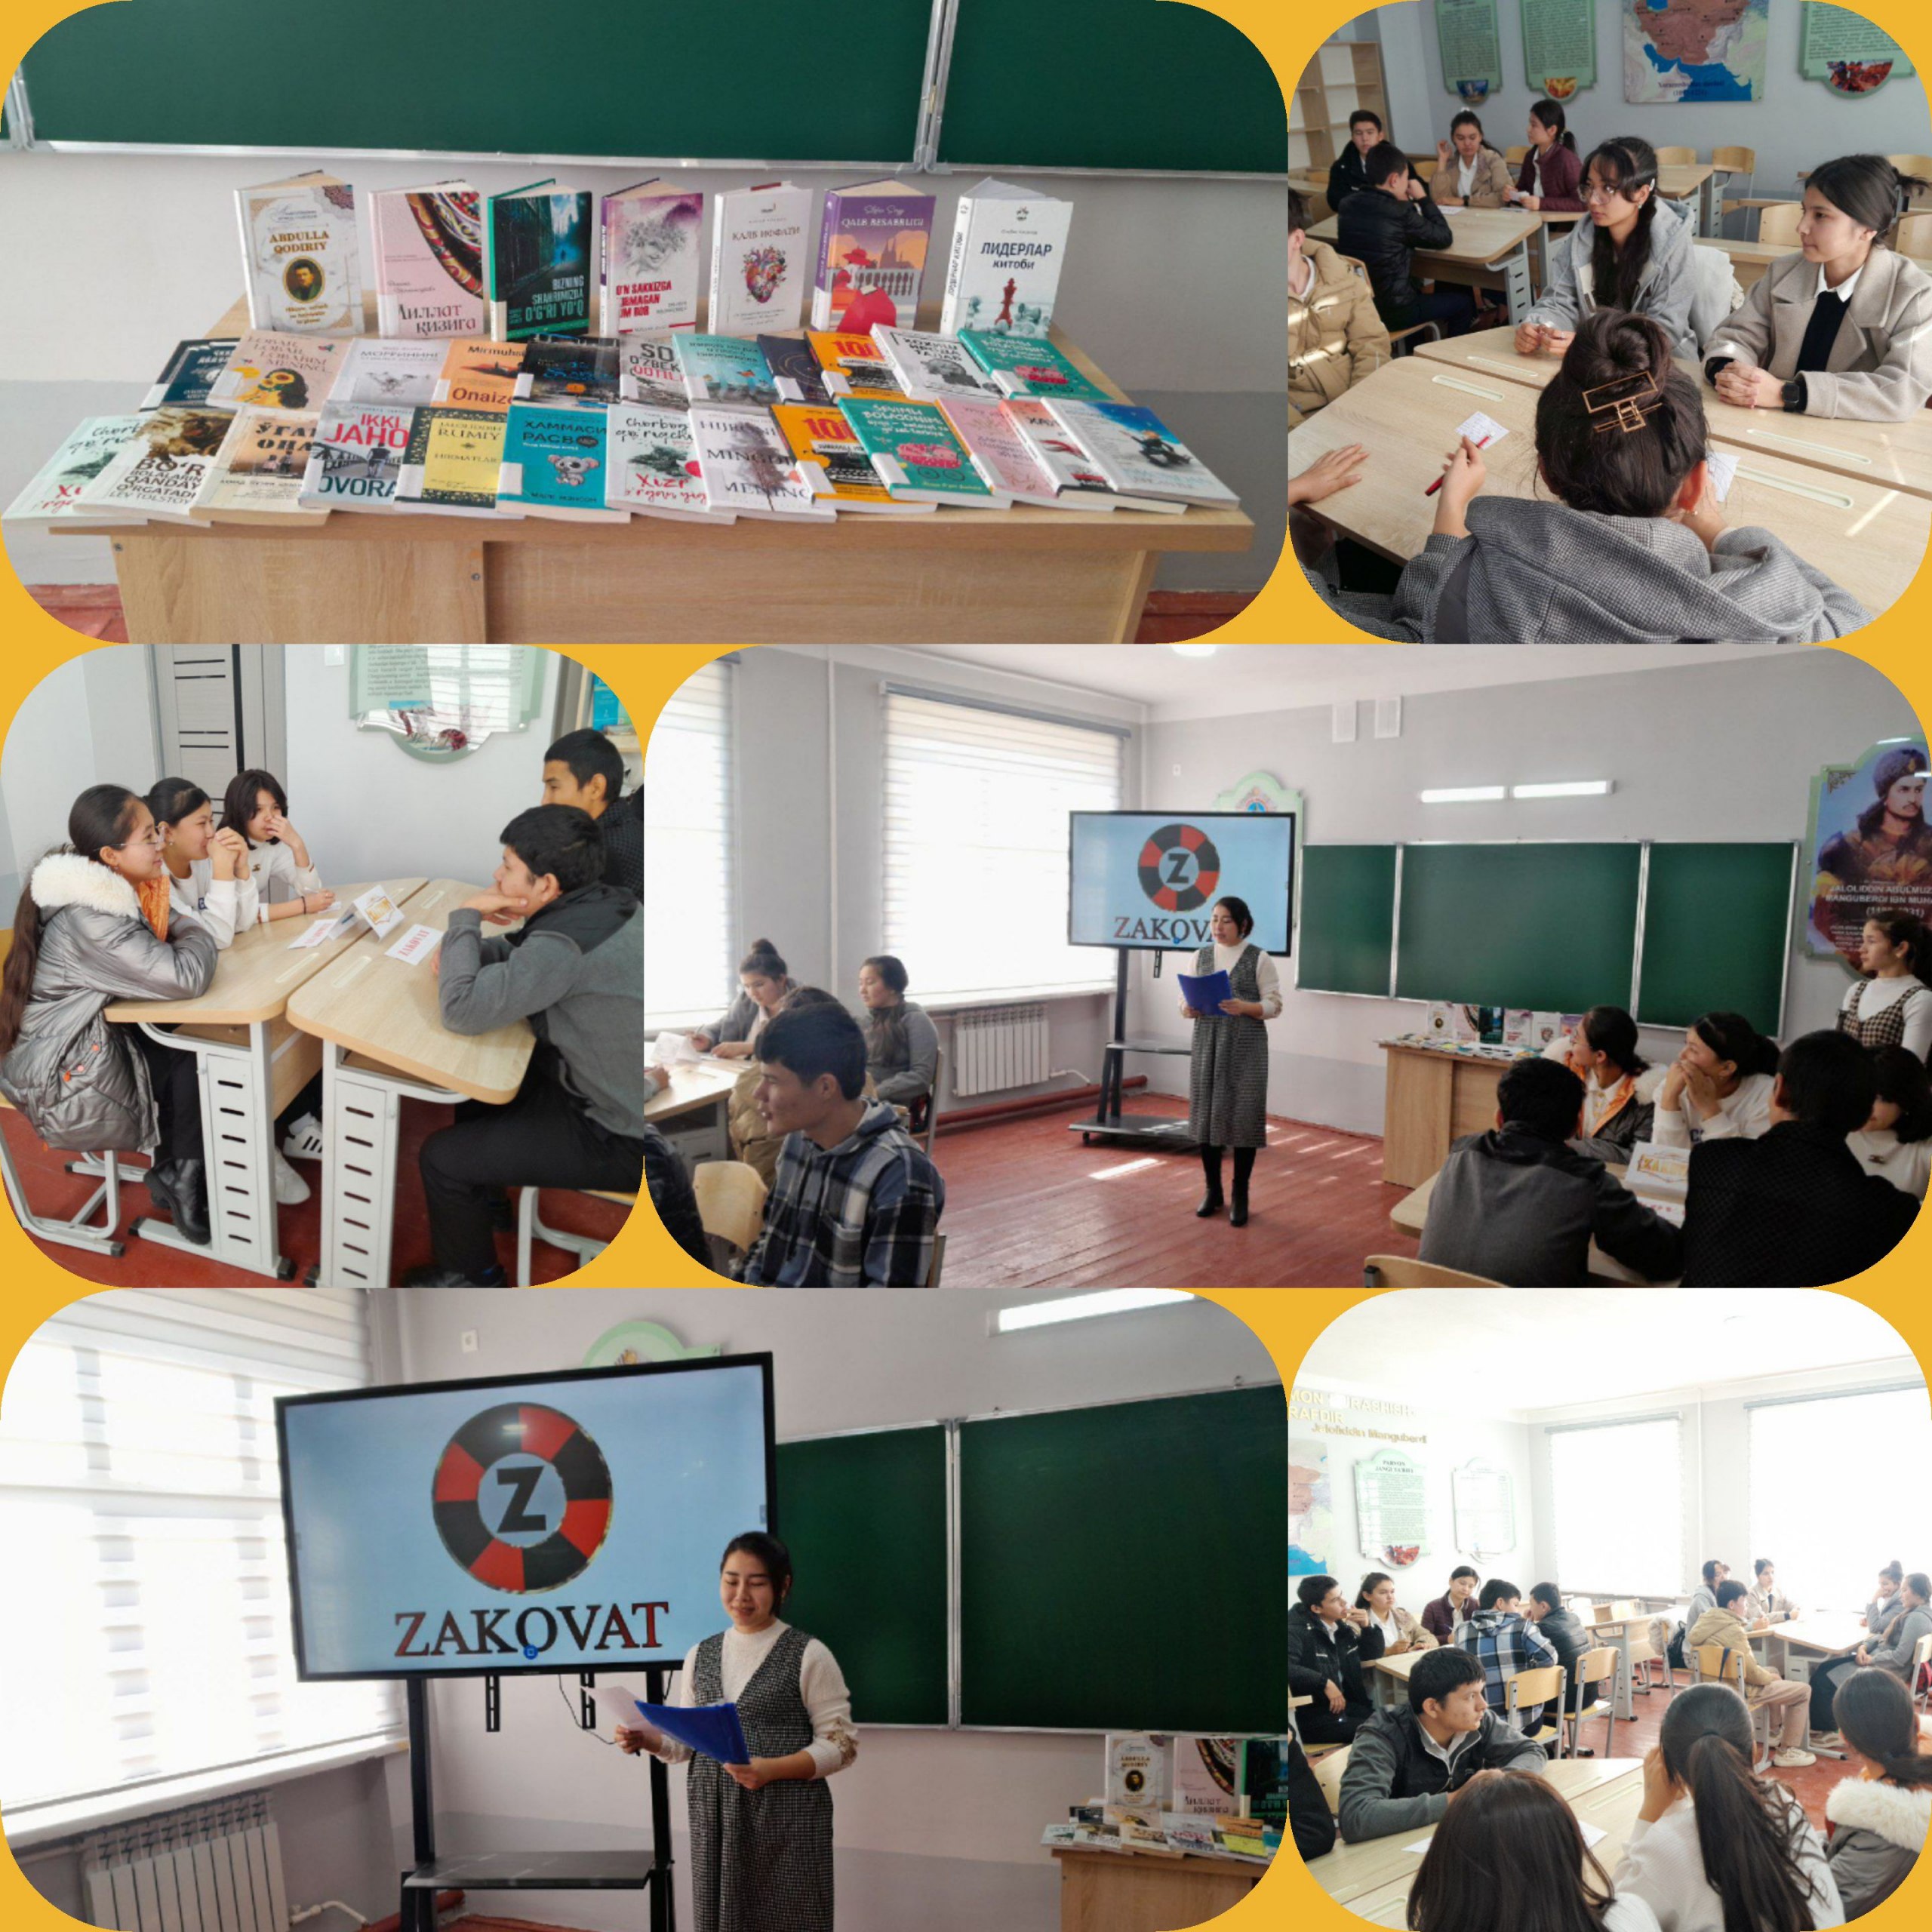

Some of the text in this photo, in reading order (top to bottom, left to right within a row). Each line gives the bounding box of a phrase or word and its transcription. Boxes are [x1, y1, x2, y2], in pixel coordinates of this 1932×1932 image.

[269, 230, 330, 243] ABDULLA
[274, 241, 327, 254] QODIRIY
[980, 242, 1053, 258] ЛИДЕРЛАР
[992, 259, 1035, 269] китоби
[361, 413, 400, 429] IKKI
[322, 423, 410, 448] JAHO
[438, 429, 500, 441] RUMIY
[124, 475, 201, 490] QANDAY
[1166, 853, 1190, 883] Z
[497, 1466, 547, 1534] Z
[394, 1601, 669, 1657] ZAKOVAT
